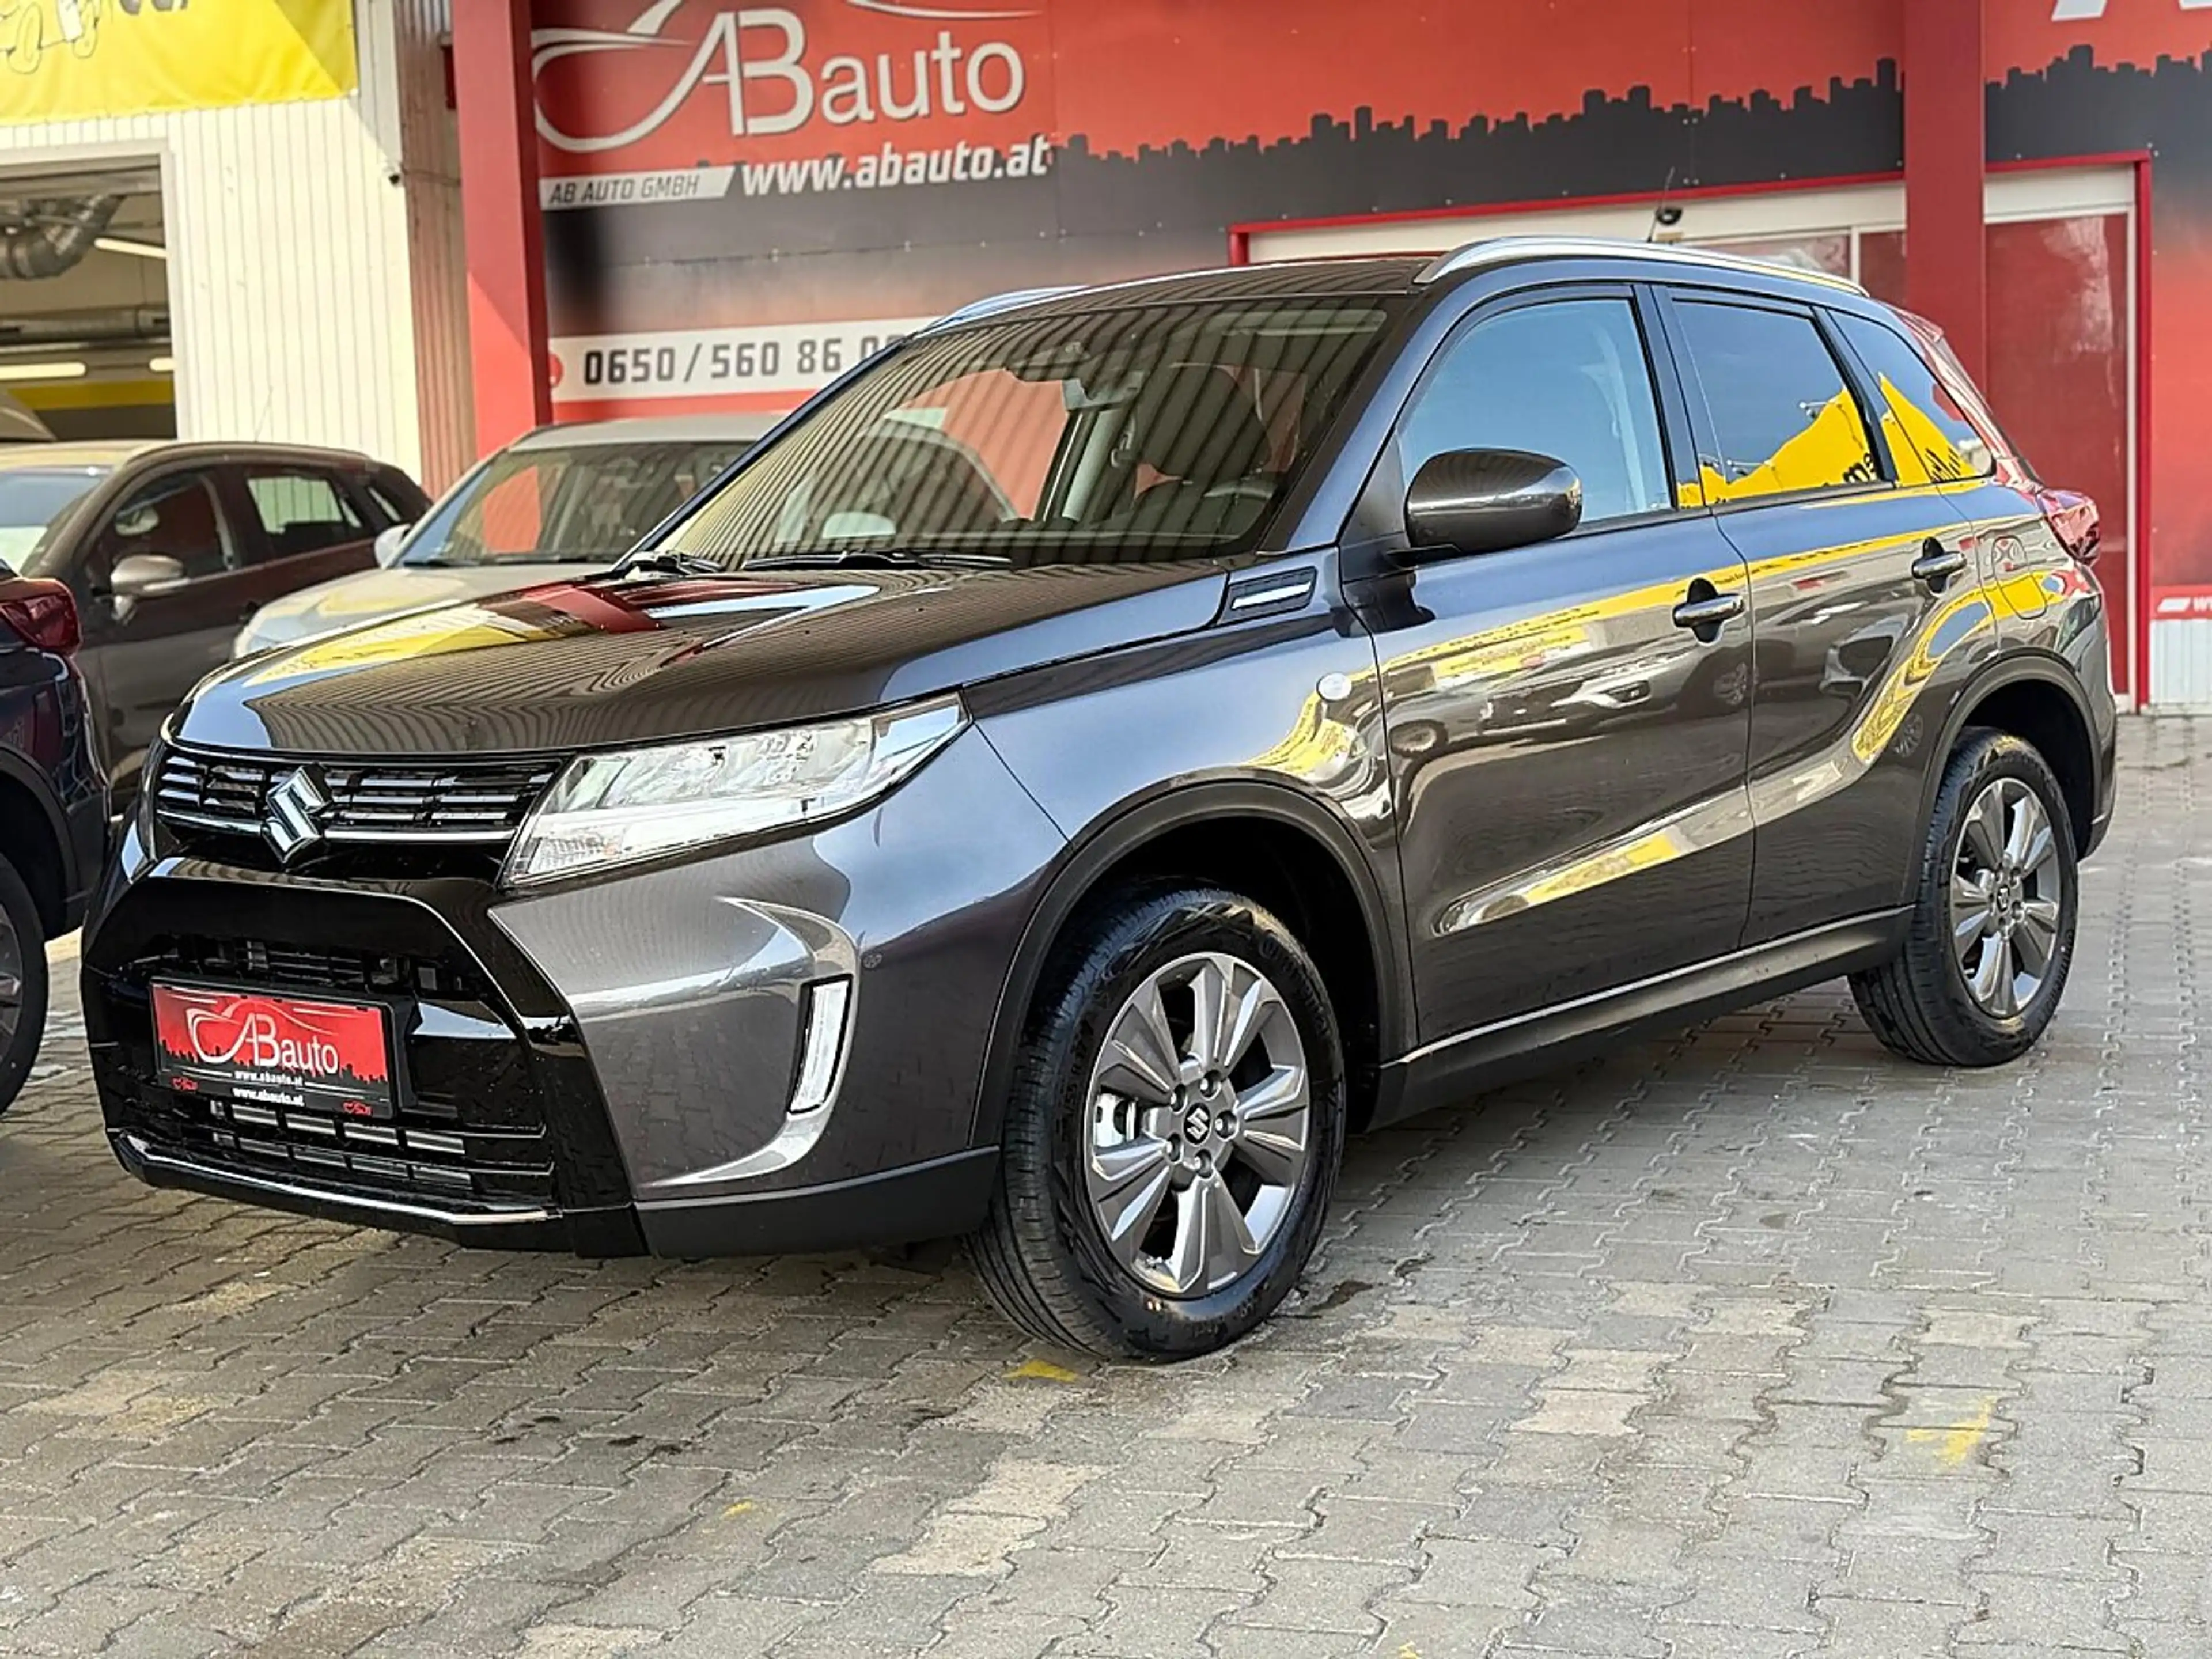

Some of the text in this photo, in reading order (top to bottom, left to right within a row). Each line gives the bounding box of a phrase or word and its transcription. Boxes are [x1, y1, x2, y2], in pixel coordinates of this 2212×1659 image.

[550, 175, 700, 203] AB AUTO GMBH
[743, 135, 1050, 196] www.abauto.at
[584, 348, 676, 385] 0650
[710, 342, 781, 379] 560
[797, 338, 842, 374] 86
